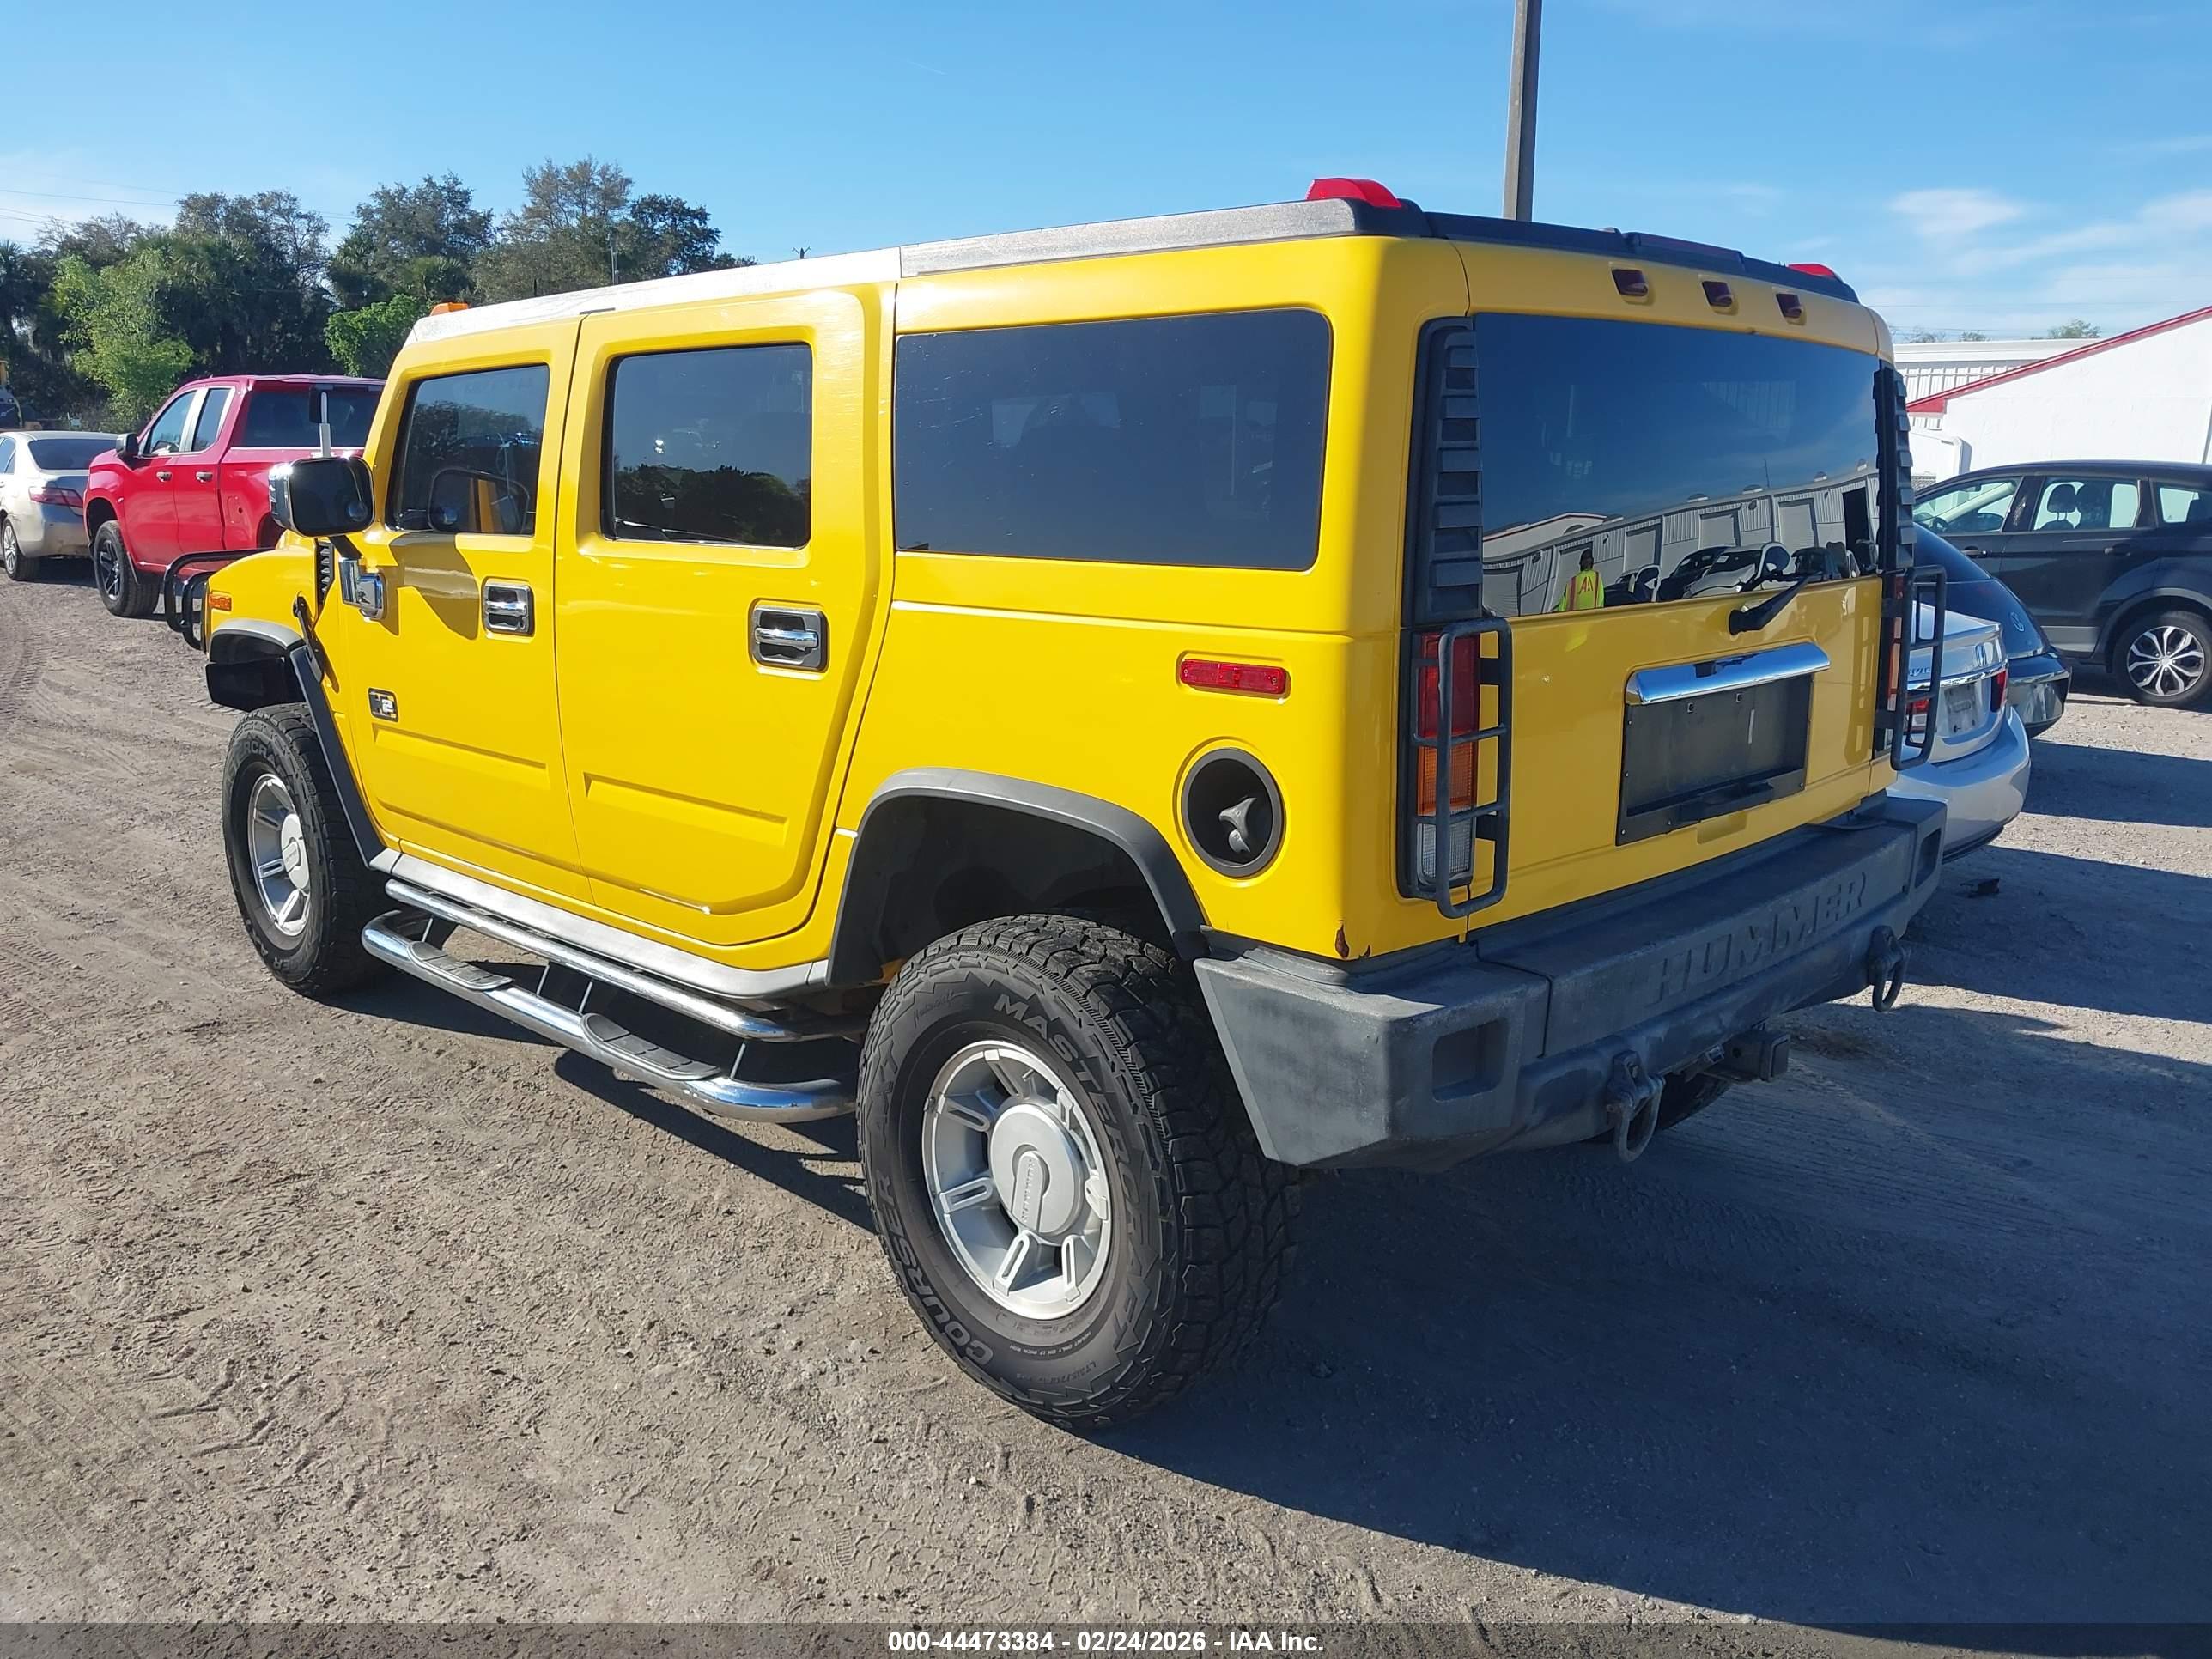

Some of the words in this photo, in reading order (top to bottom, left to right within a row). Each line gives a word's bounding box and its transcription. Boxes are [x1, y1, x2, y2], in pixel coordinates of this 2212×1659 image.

[1656, 871, 1868, 1003] HUMMER
[876, 1170, 994, 1365] COURSER
[993, 994, 1142, 1352] MASTERCRAFT
